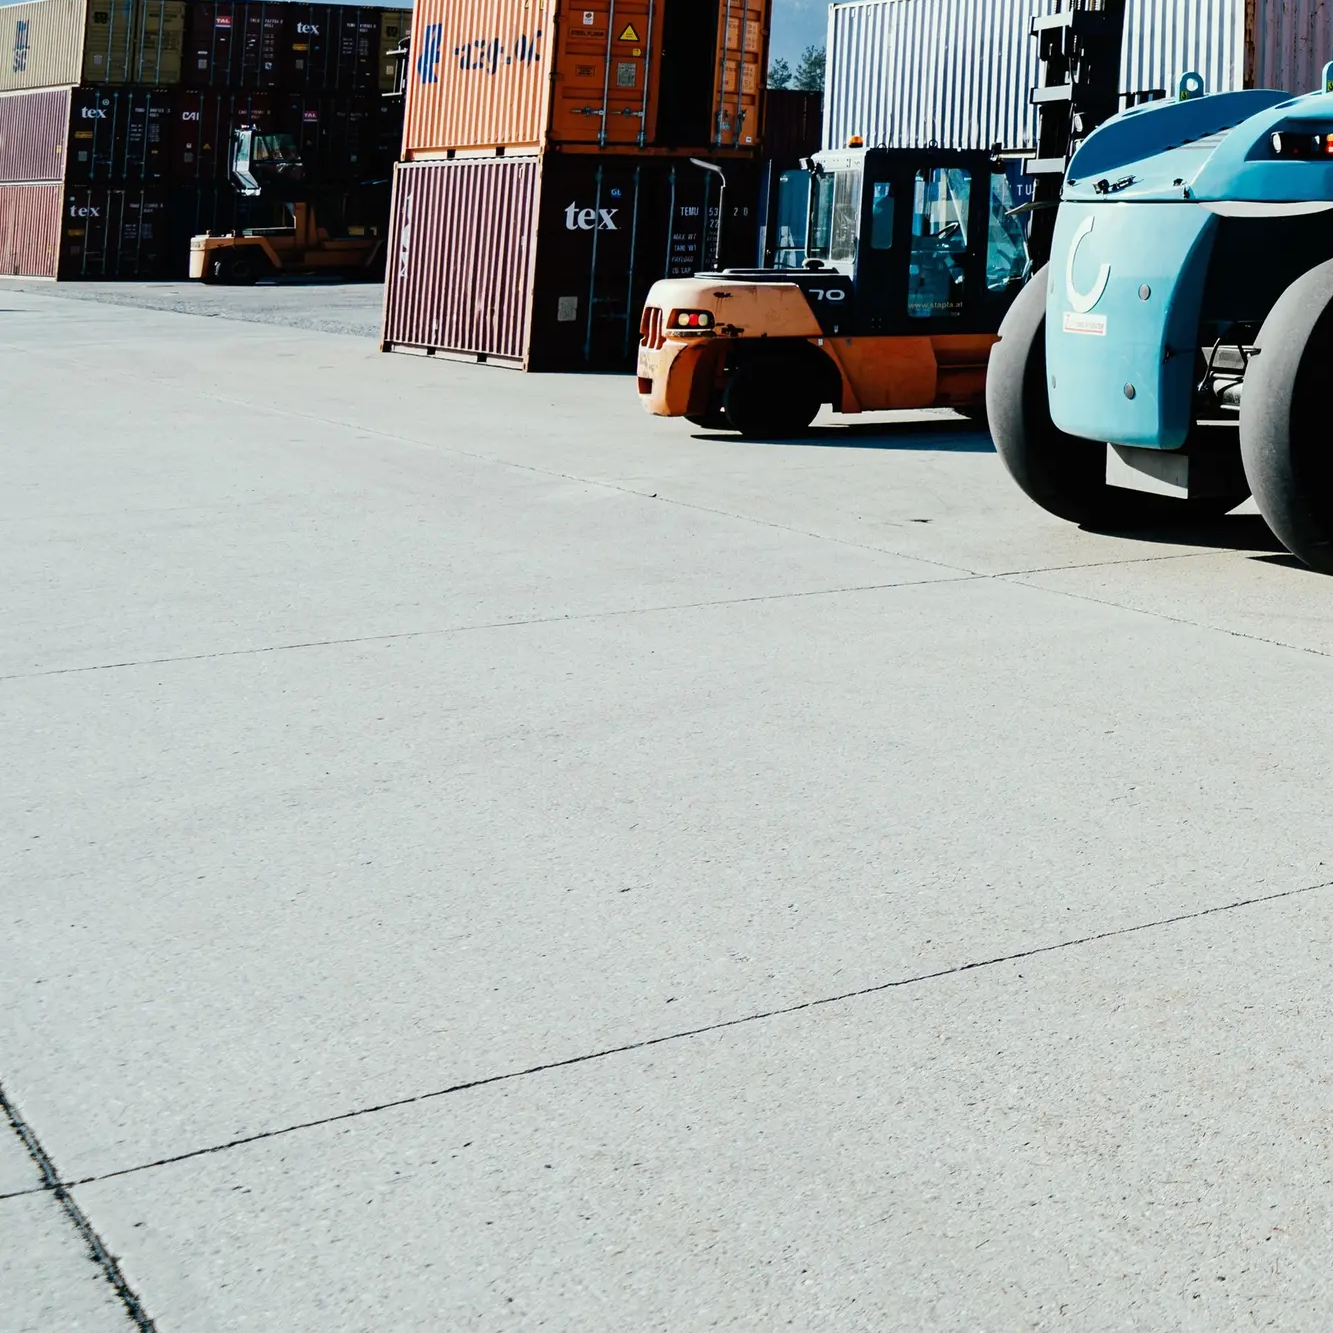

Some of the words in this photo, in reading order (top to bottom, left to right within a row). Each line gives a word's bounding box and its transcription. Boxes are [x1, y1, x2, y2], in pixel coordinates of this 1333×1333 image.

[296, 21, 320, 35] tex
[81, 105, 107, 119] tex
[182, 112, 200, 121] CAI
[69, 204, 101, 218] tex
[564, 200, 621, 231] tex
[680, 206, 700, 216] TEMU
[808, 289, 846, 301] 70
